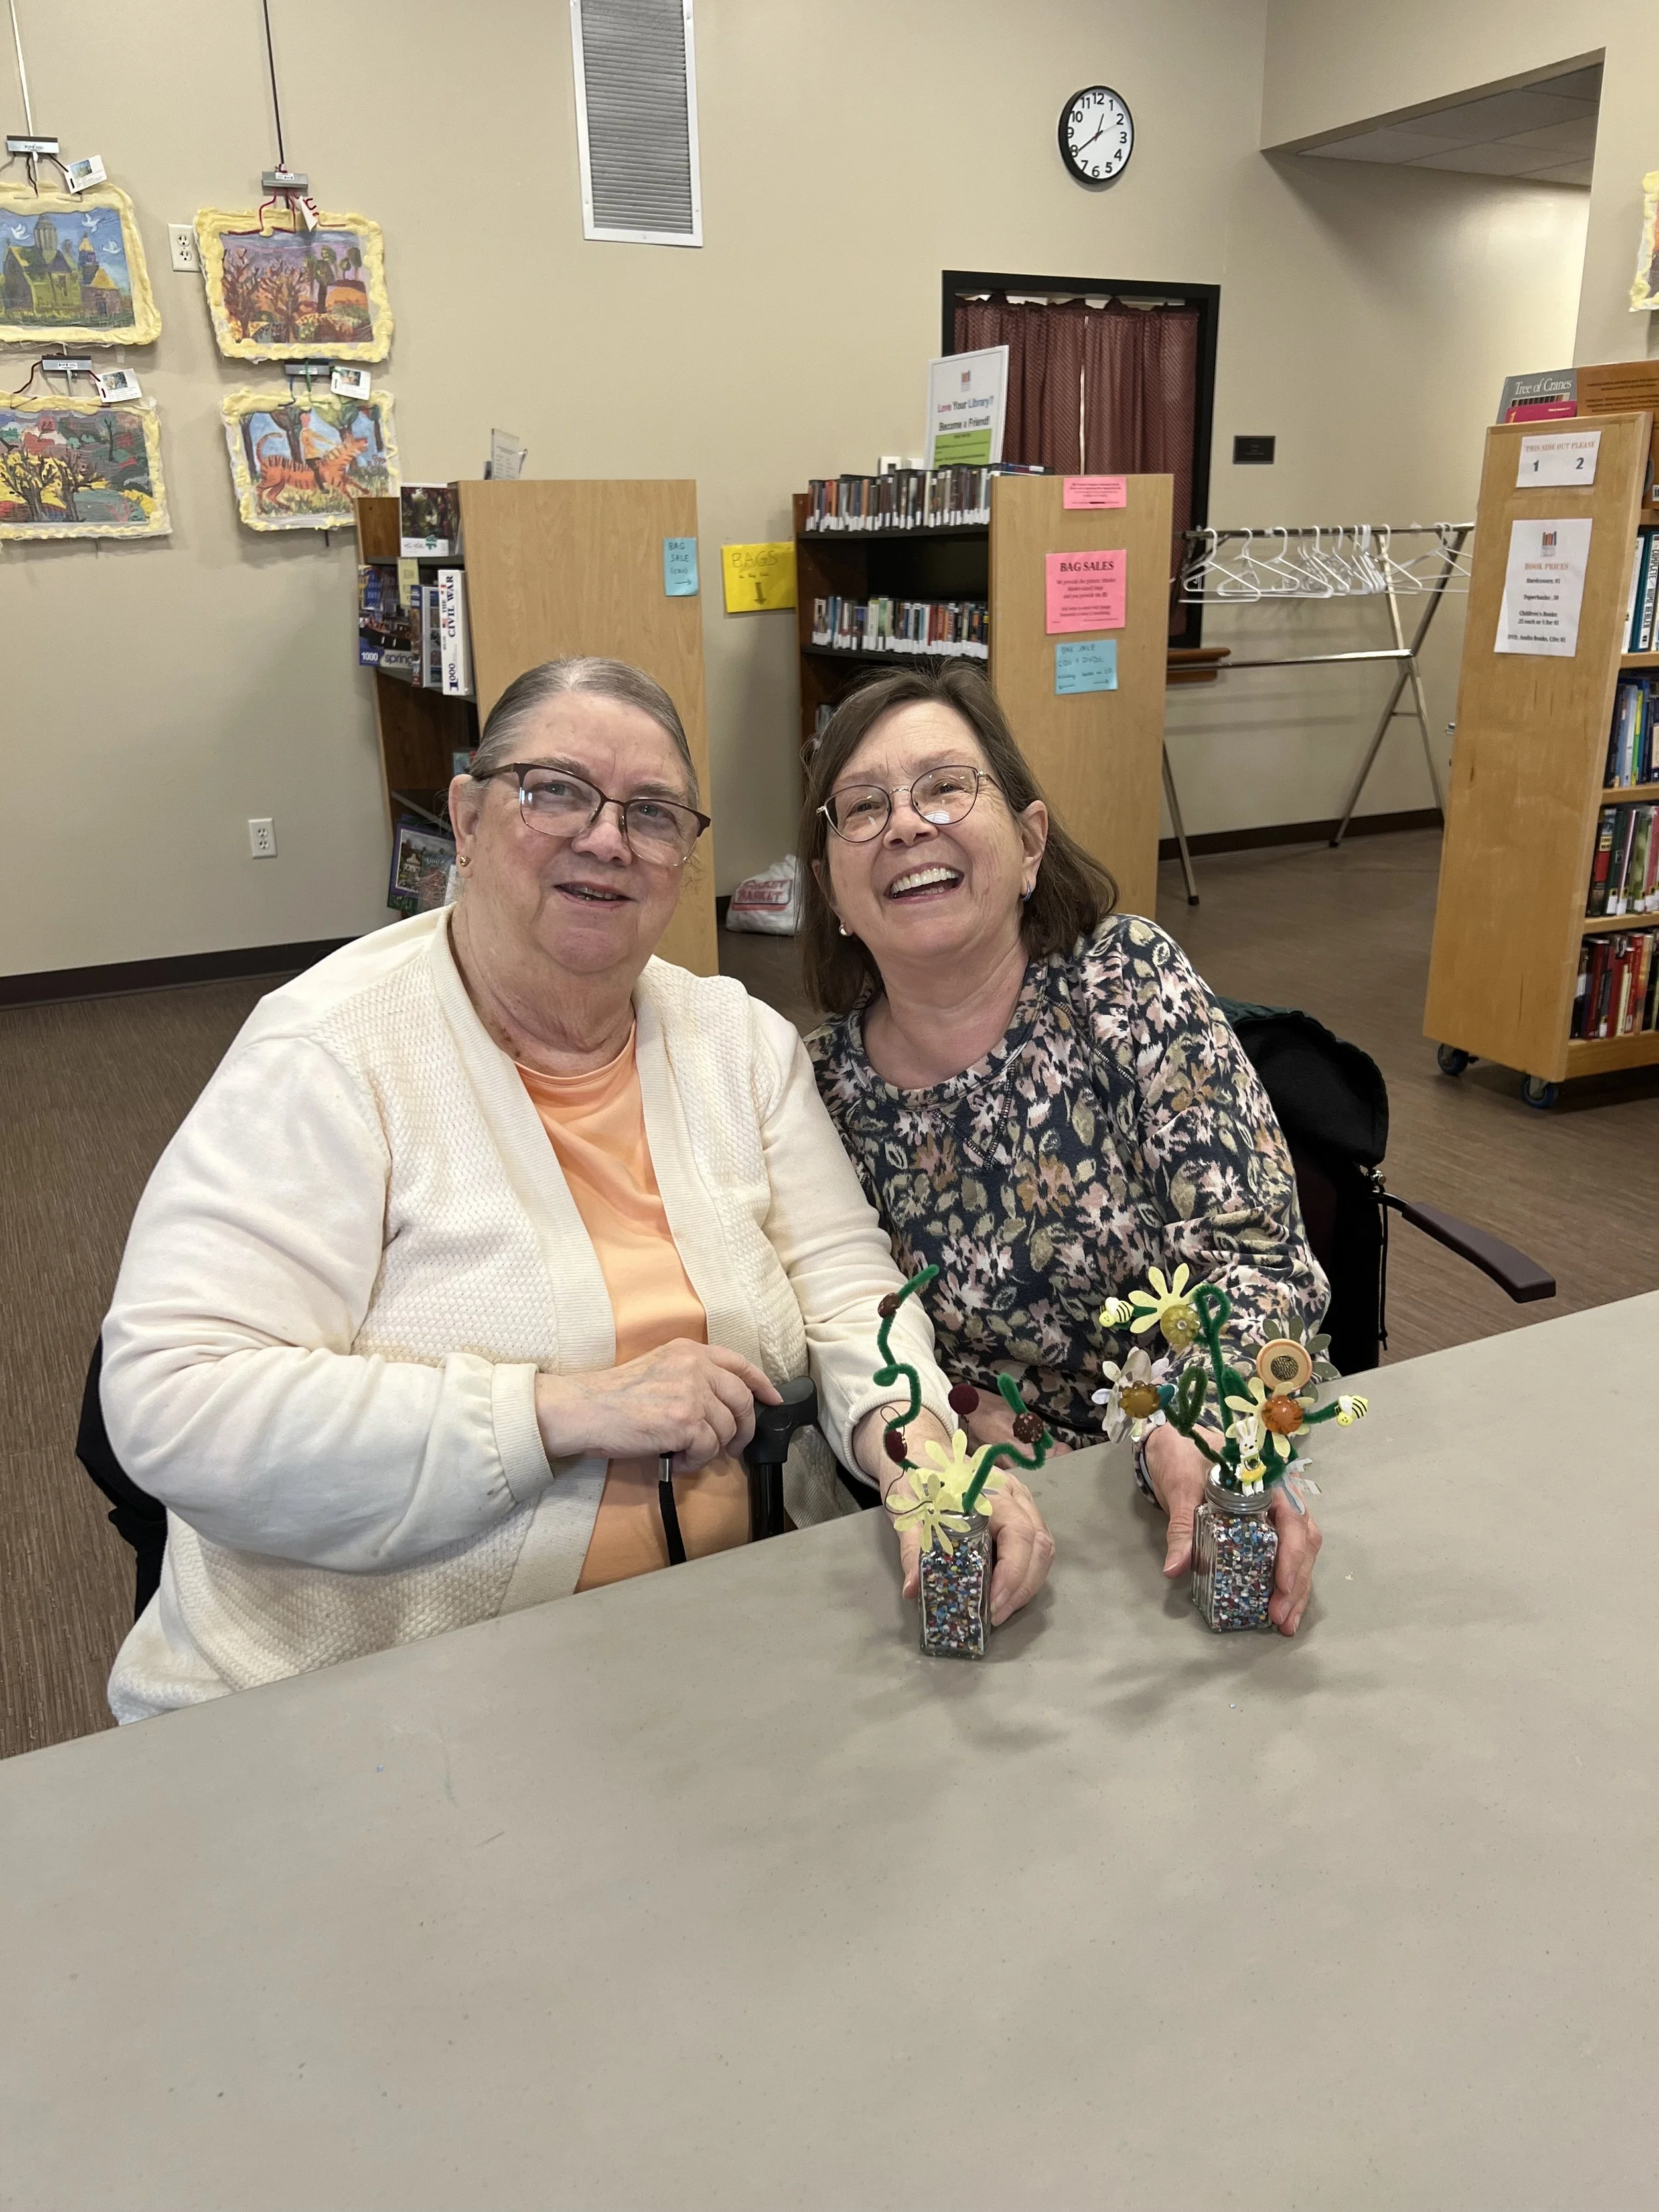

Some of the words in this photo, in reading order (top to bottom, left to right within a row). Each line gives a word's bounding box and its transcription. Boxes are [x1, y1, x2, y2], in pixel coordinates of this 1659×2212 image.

[1081, 96, 1090, 109] 11
[1092, 92, 1104, 105] 12
[1109, 100, 1114, 111] 1
[1071, 110, 1083, 123] 10
[1116, 113, 1124, 125] 2
[1067, 126, 1074, 138] 9
[1119, 131, 1127, 143] 3
[1070, 145, 1078, 157] 8
[1114, 149, 1122, 161] 4
[1081, 159, 1088, 171] 7
[1105, 162, 1112, 173] 5
[1092, 166, 1100, 177] 6
[1514, 381, 1532, 395] Tree
[1533, 378, 1544, 393] of
[1544, 378, 1573, 392] Cranes
[937, 404, 952, 413] Love
[952, 401, 967, 410] Your
[938, 421, 962, 431] Become
[1542, 443, 1555, 452] SIDE
[1571, 441, 1595, 449] PLEASE
[1533, 459, 1540, 472] 1
[1576, 457, 1585, 470] 2
[668, 542, 685, 550] BAG
[731, 550, 778, 568] BAGS
[1060, 562, 1081, 571] BAG
[1083, 561, 1114, 571] SALES
[446, 575, 455, 602] WAR
[447, 605, 456, 638] CIVIL
[361, 652, 379, 662] 1000
[448, 663, 459, 692] 1000
